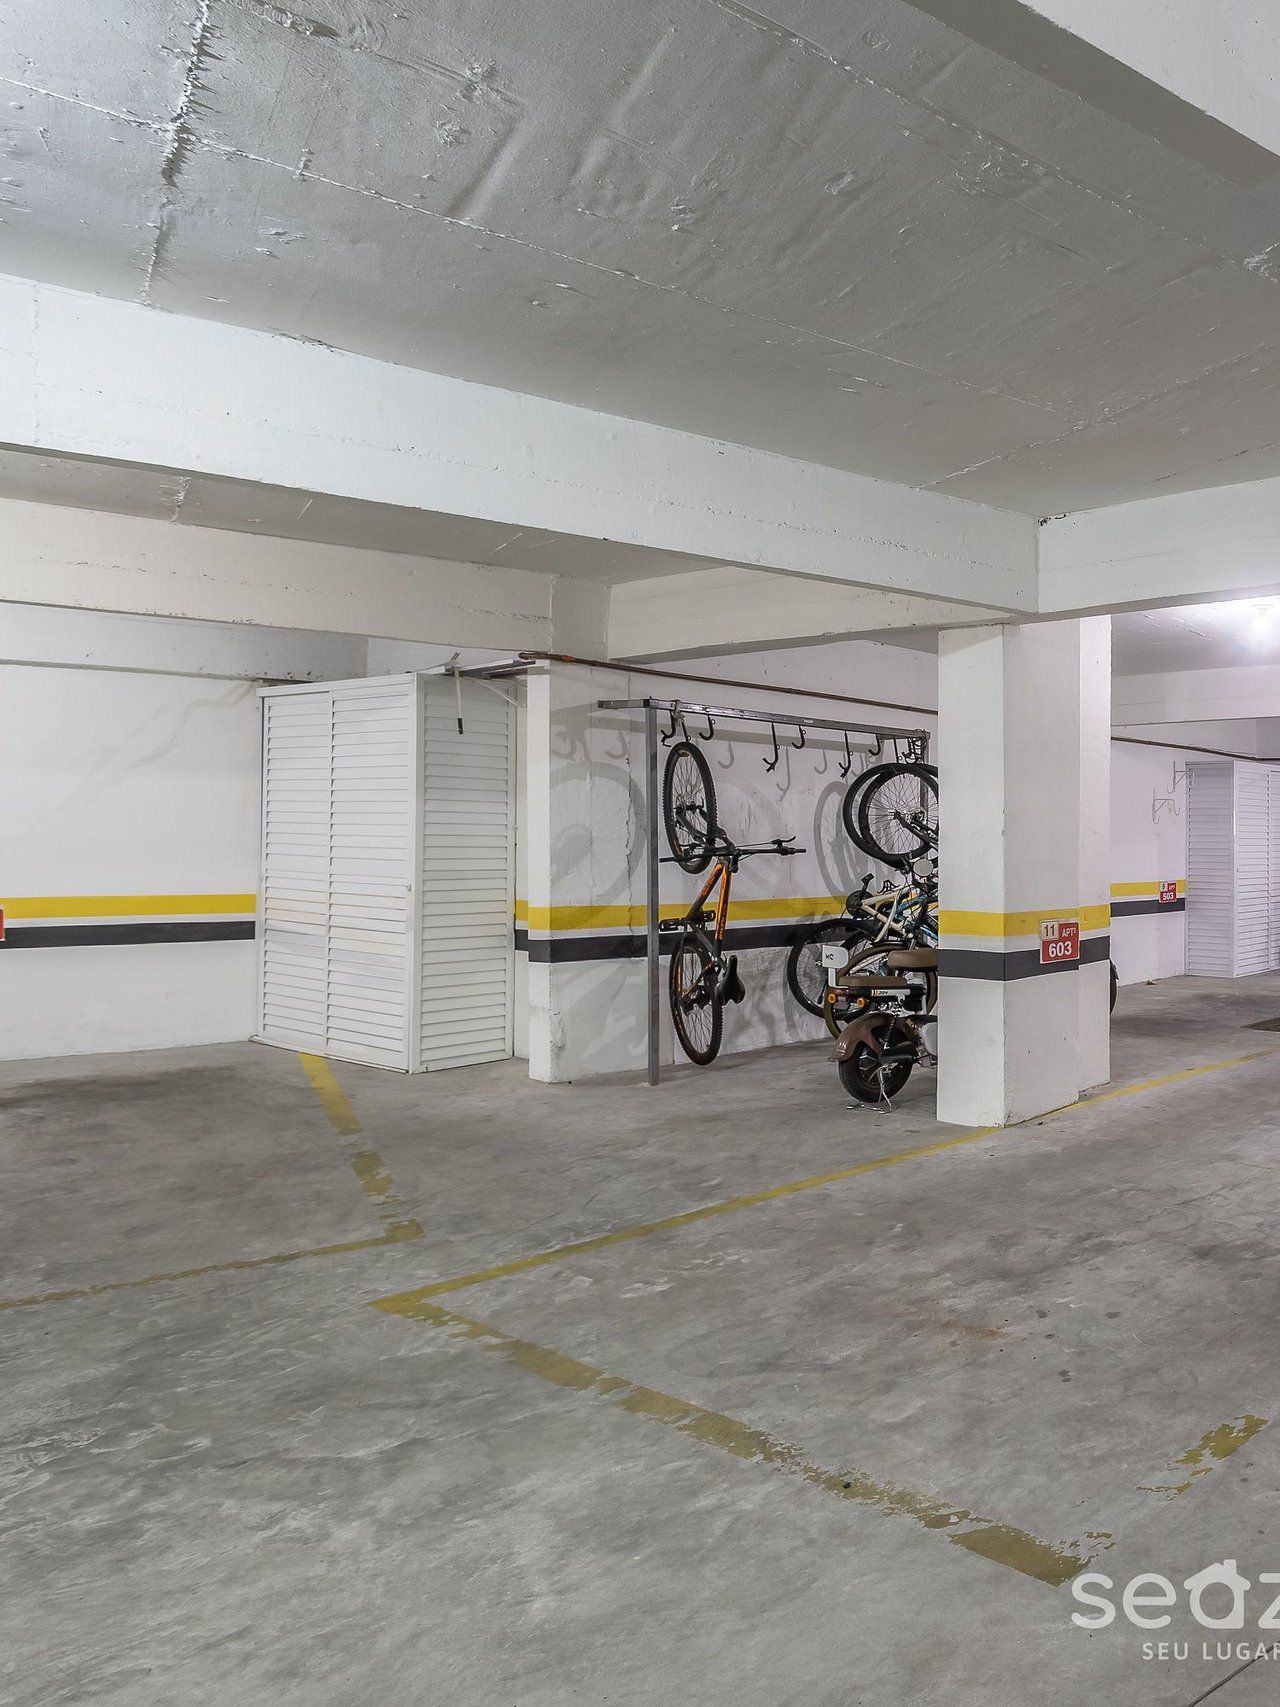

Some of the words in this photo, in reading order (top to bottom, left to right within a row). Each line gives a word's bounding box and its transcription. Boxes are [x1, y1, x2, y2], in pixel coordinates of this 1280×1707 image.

[1162, 892, 1174, 900] 503
[1044, 924, 1055, 937] 11
[1048, 941, 1072, 958] 603
